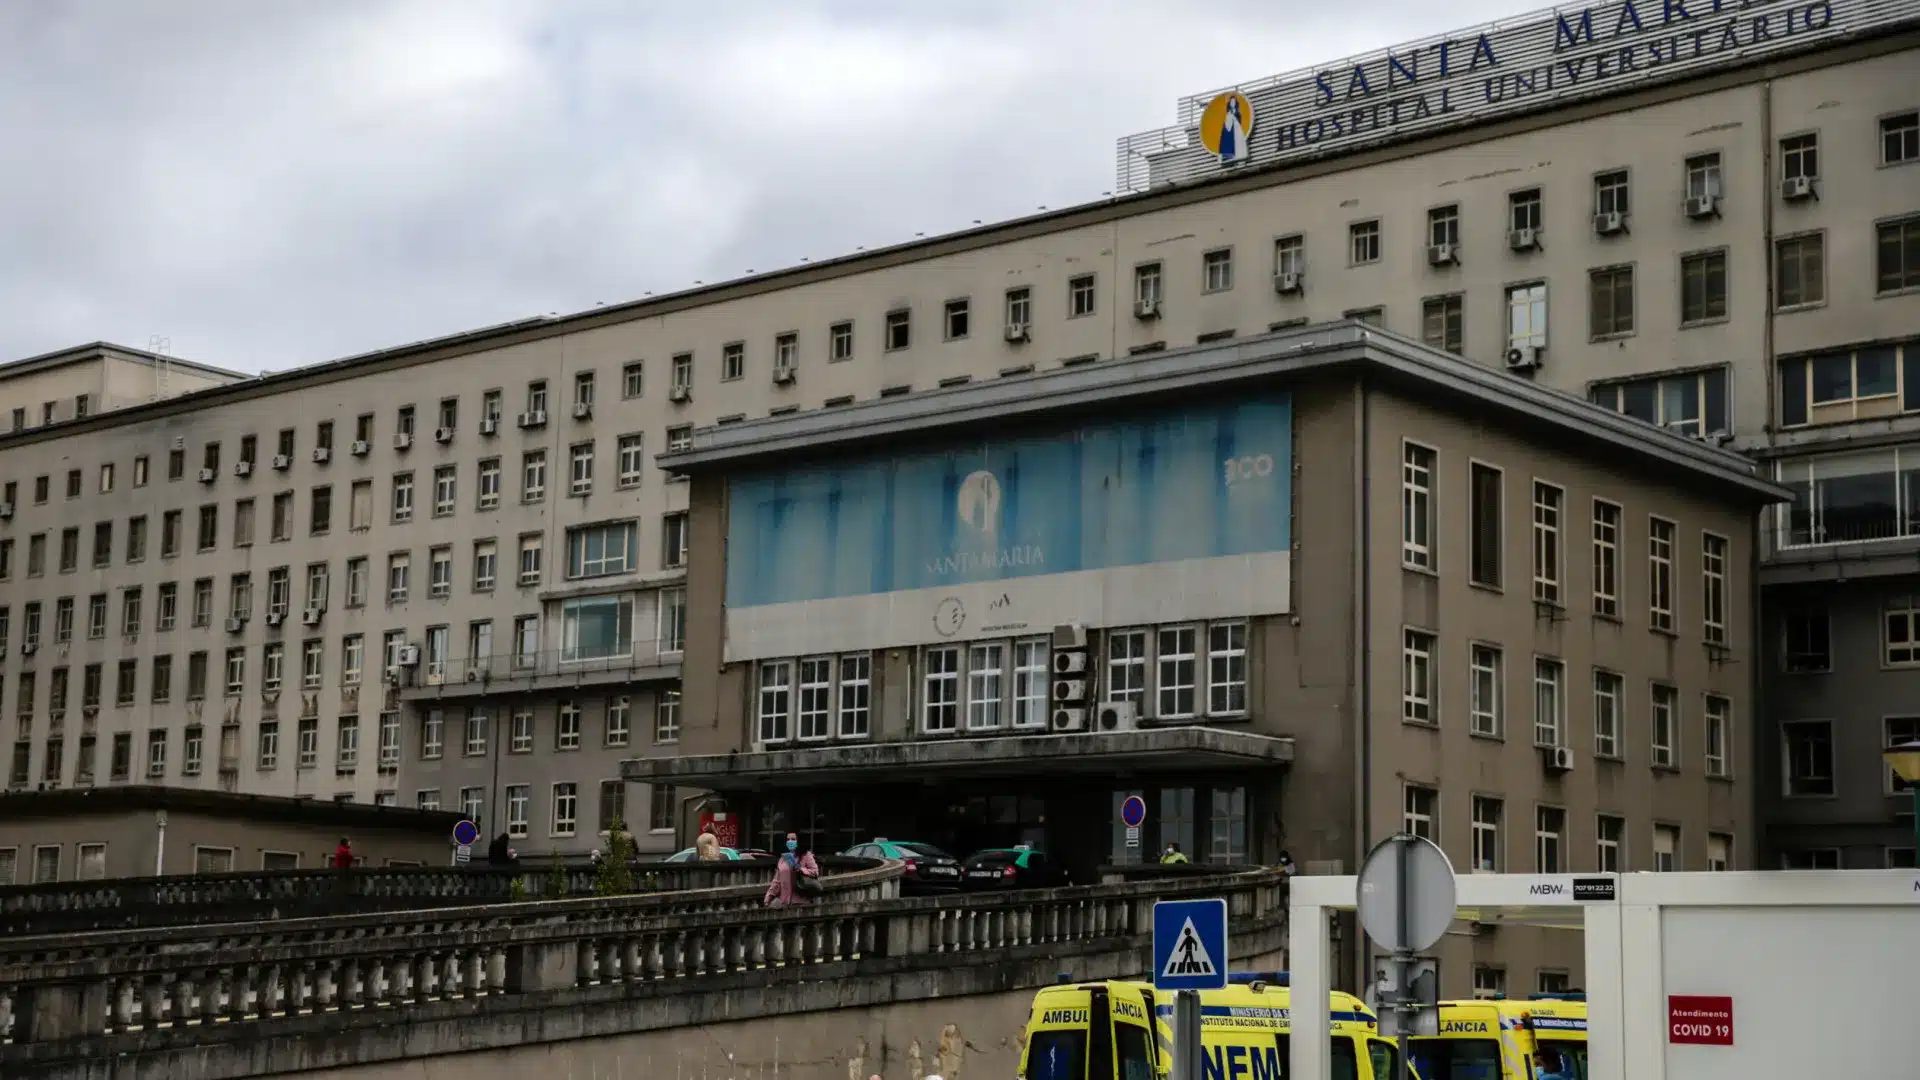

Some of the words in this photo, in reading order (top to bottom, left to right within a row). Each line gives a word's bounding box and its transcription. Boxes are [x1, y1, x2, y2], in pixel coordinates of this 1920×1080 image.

[1314, 34, 1500, 107] SANTA
[1276, 88, 1455, 151] HOSPITAL
[1530, 884, 1563, 895] MBW
[1672, 1009, 1729, 1018] Atendimento
[1201, 1017, 1234, 1026] NSTITUTO
[1235, 1019, 1267, 1028] NACIONAL
[1270, 1020, 1278, 1028] DE
[1673, 1024, 1712, 1037] COVID
[1715, 1025, 1729, 1037] 19
[1201, 1045, 1283, 1080] NEM
